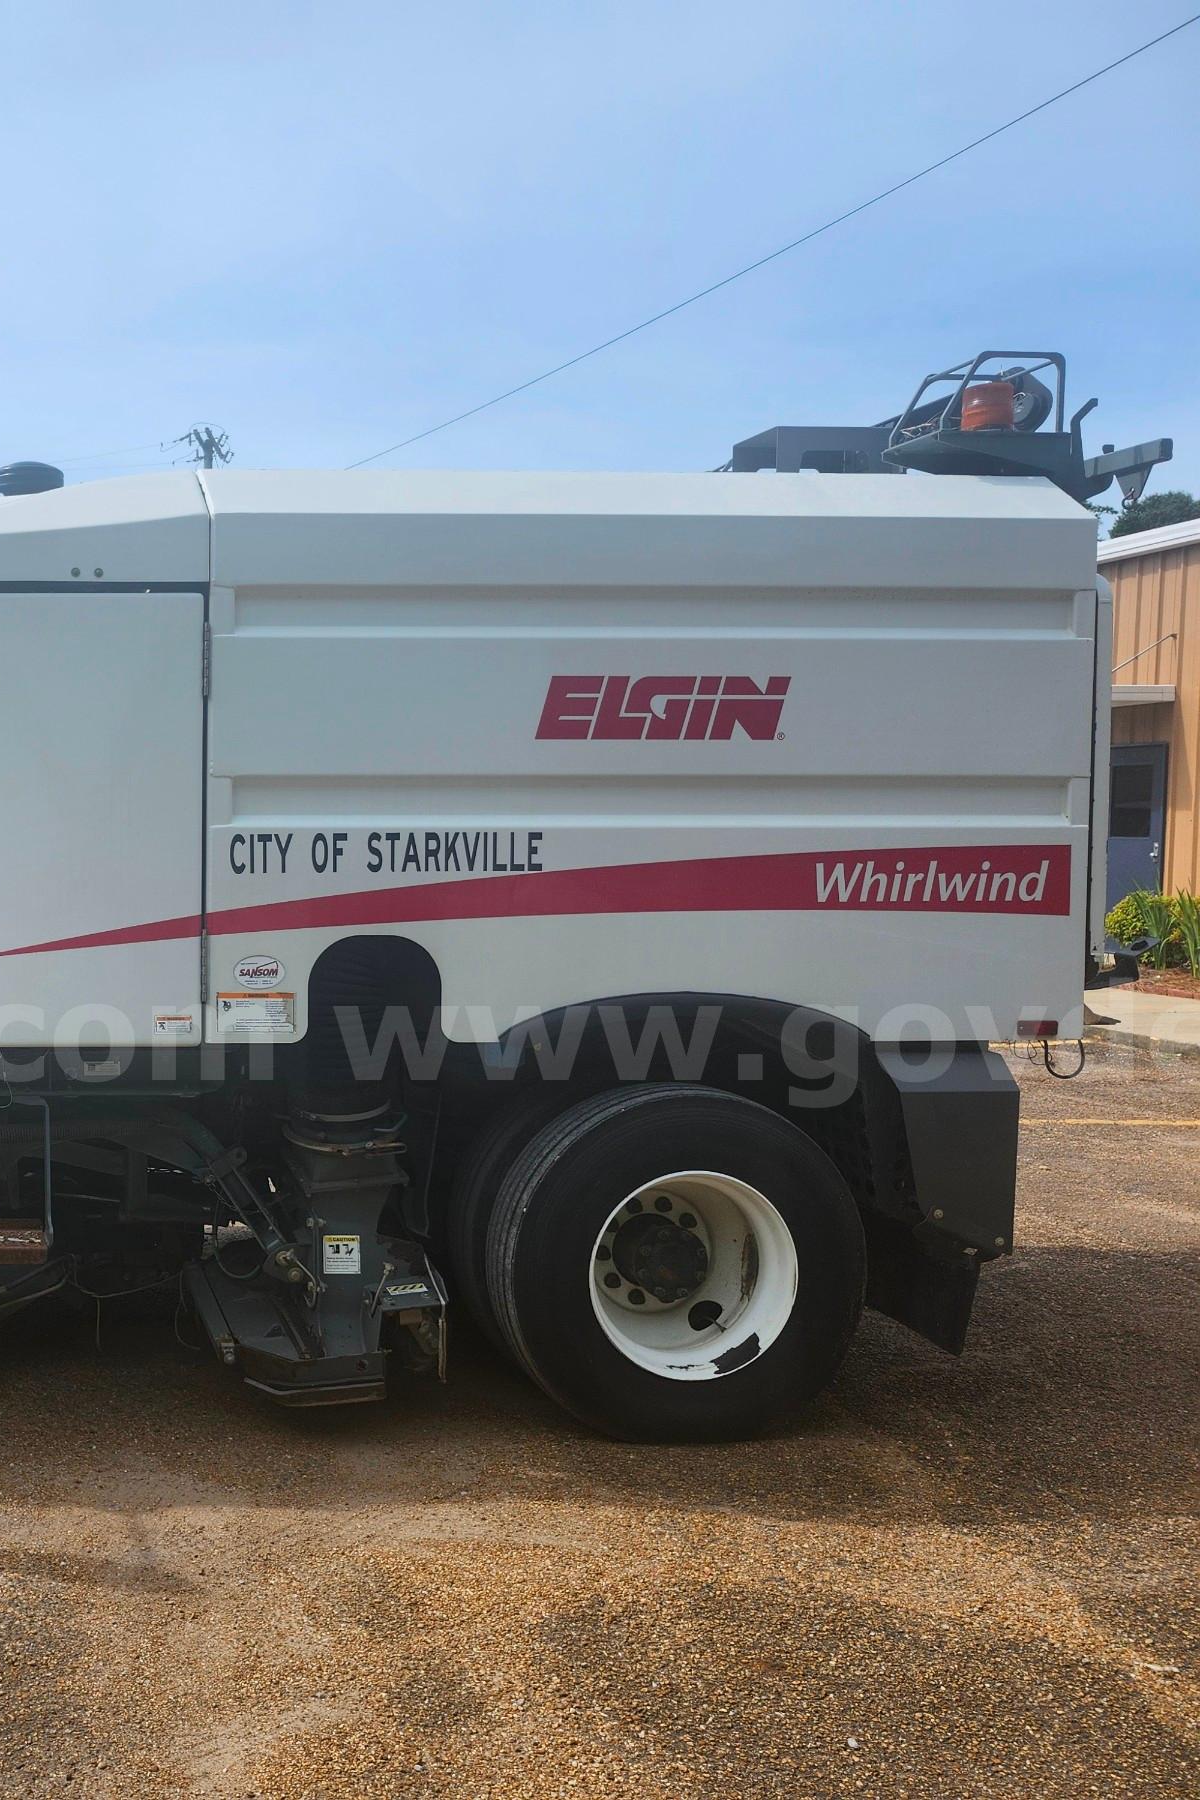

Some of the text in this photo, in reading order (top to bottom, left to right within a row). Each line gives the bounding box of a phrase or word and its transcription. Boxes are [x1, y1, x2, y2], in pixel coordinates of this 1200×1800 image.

[535, 675, 792, 741] ELGIN
[229, 831, 544, 875] CITY OF STARKVILLE
[814, 859, 1050, 904] Whirlwind
[238, 967, 279, 978] SANSOM
